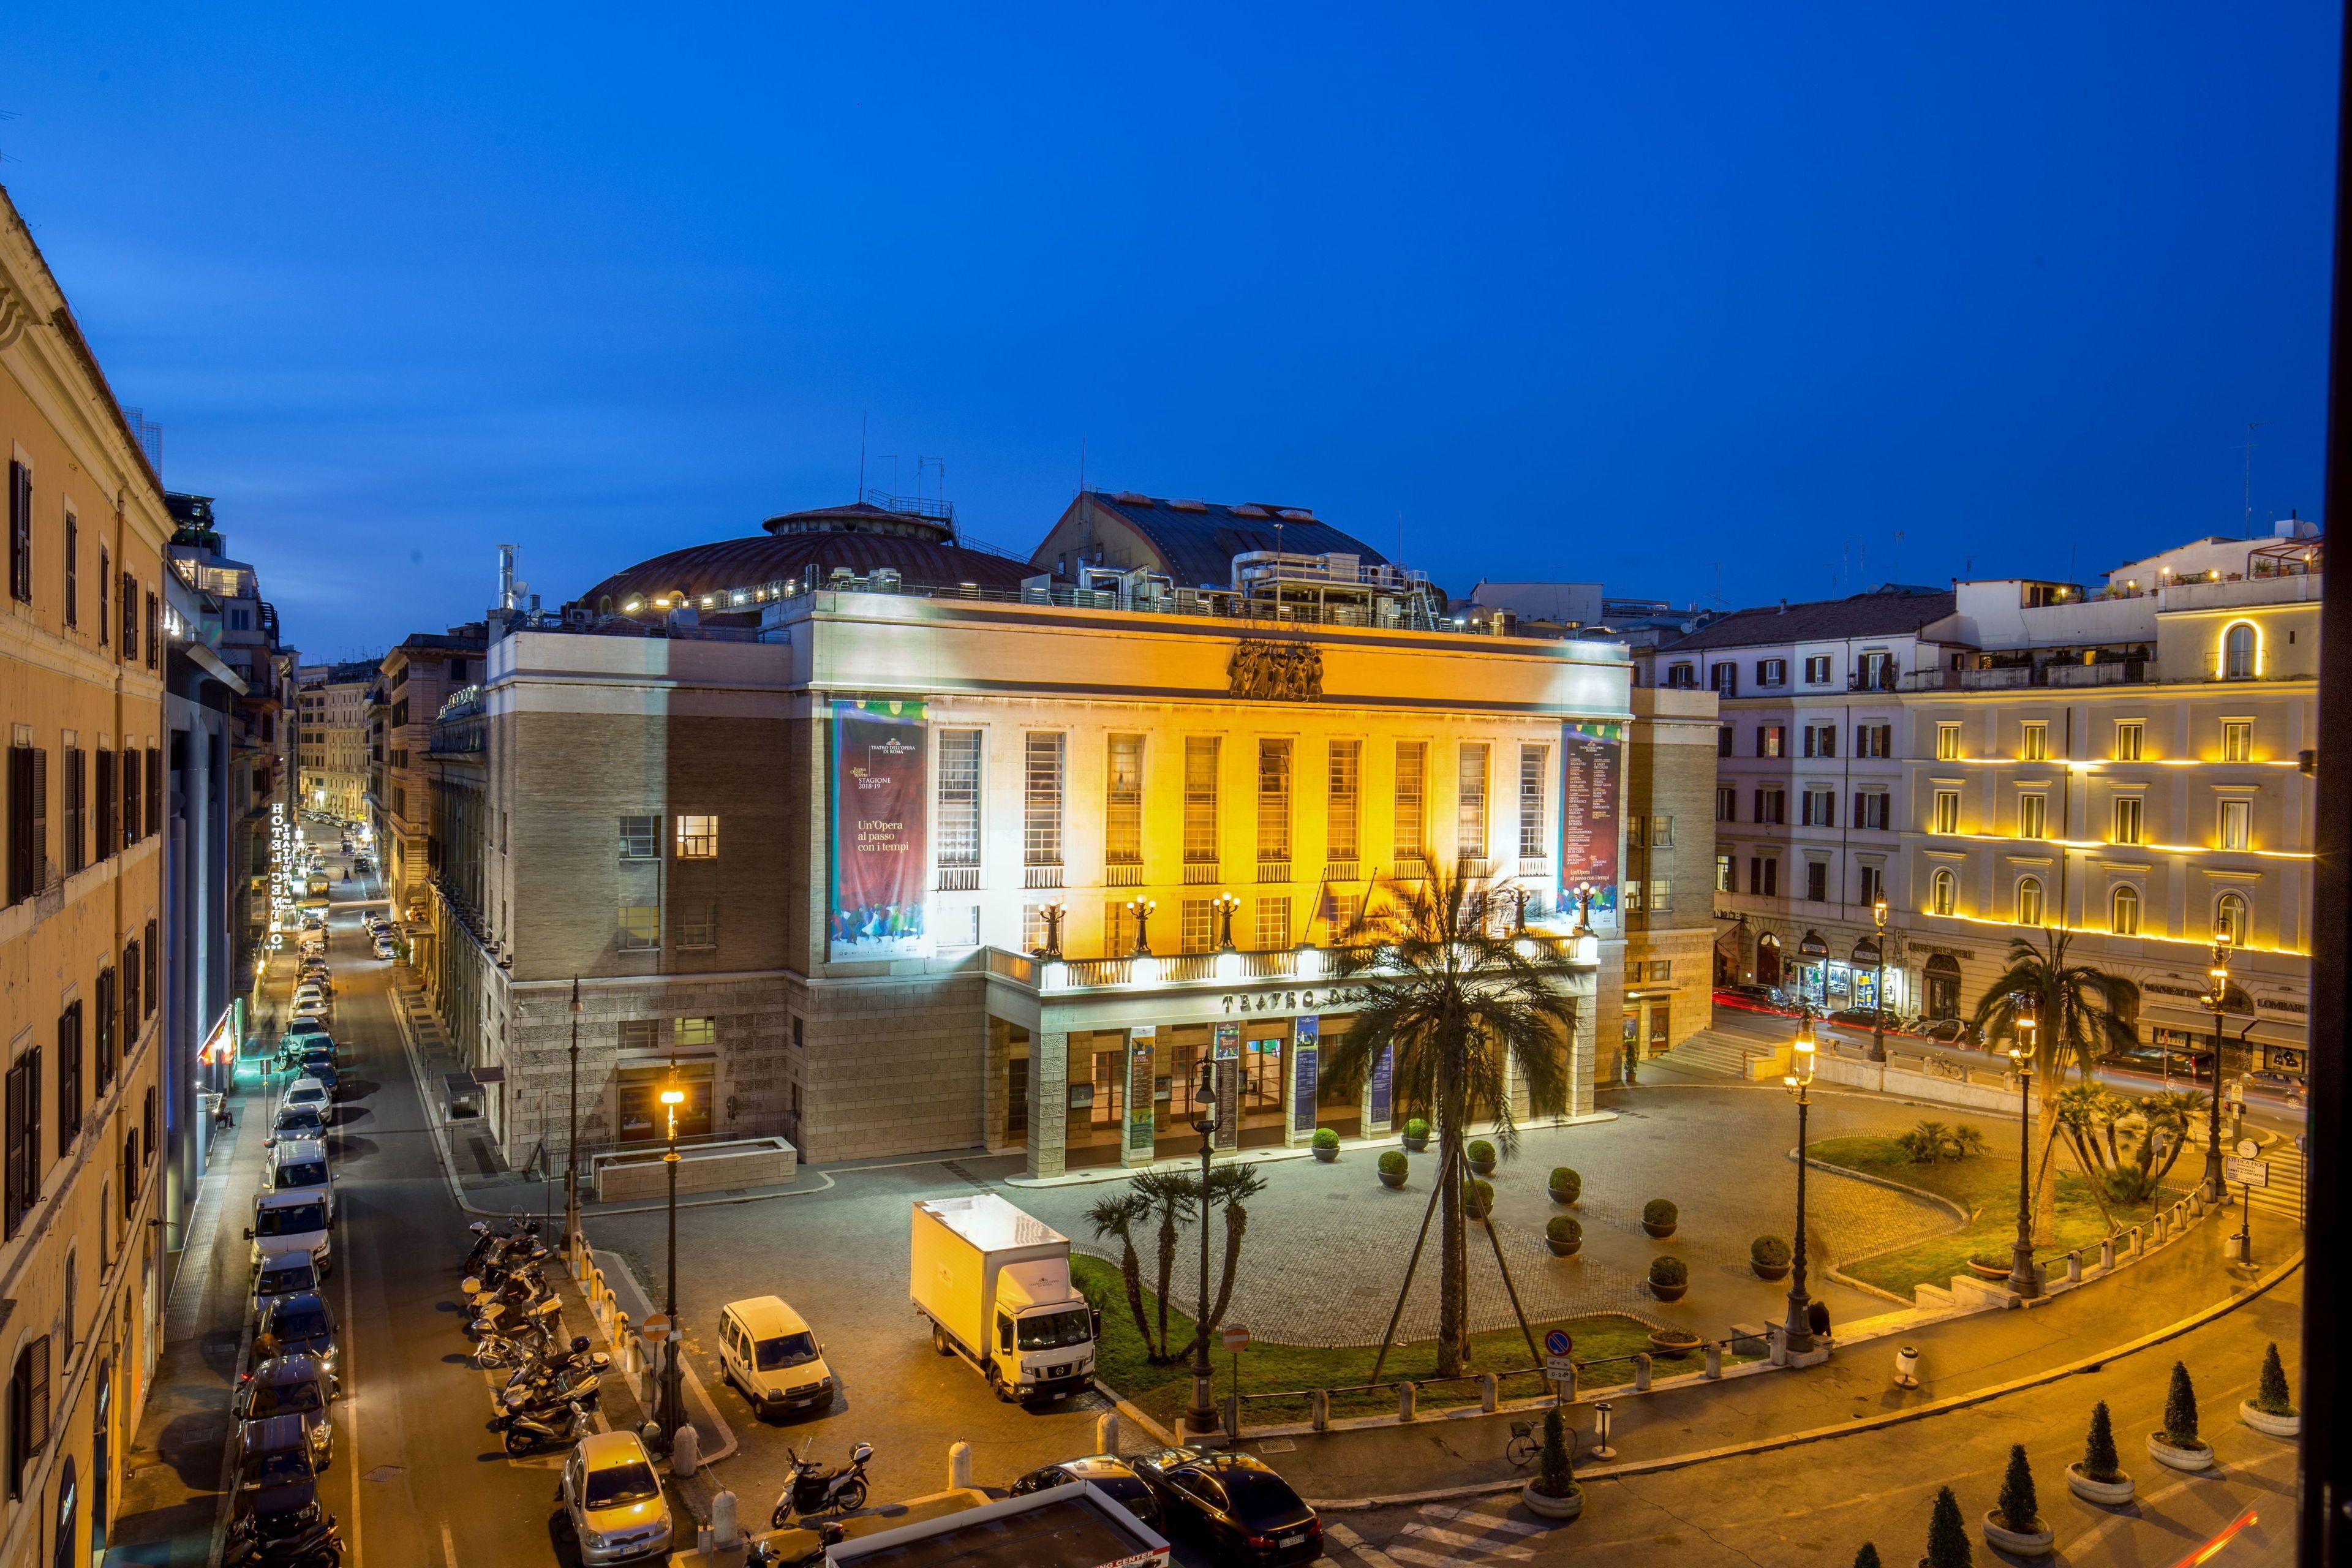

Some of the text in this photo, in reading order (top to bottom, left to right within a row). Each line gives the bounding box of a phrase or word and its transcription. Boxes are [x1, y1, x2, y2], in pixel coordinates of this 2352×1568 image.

[858, 820, 903, 832] Un'Opera
[858, 832, 895, 842] al passo
[877, 842, 880, 851] i
[883, 842, 909, 853] tempi
[1223, 990, 1314, 1012] TEATRO
[2228, 1157, 2250, 1166] OTTICA
[1115, 1551, 1155, 1566] CENTER
